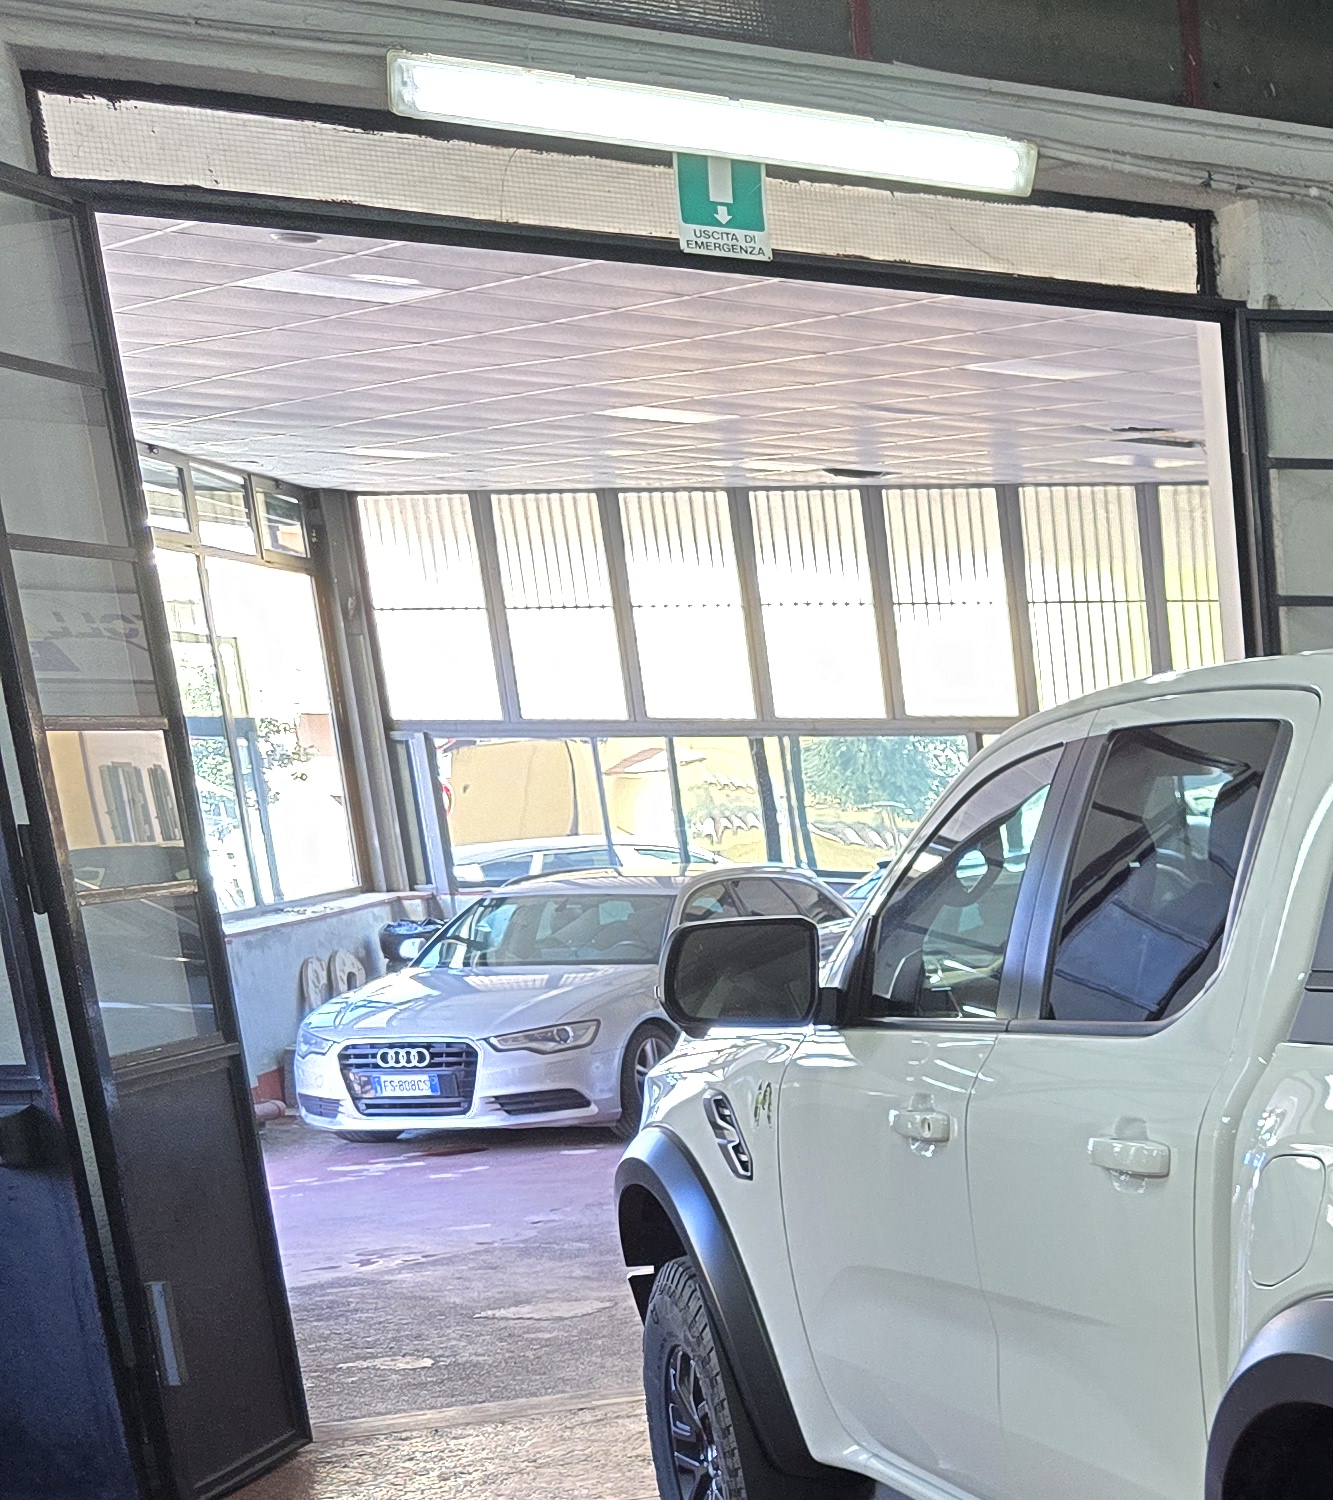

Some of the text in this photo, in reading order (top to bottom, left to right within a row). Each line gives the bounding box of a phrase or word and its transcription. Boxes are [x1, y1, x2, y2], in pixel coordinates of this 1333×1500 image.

[693, 228, 757, 244] USCITA DI
[686, 240, 766, 257] EMERGENZA
